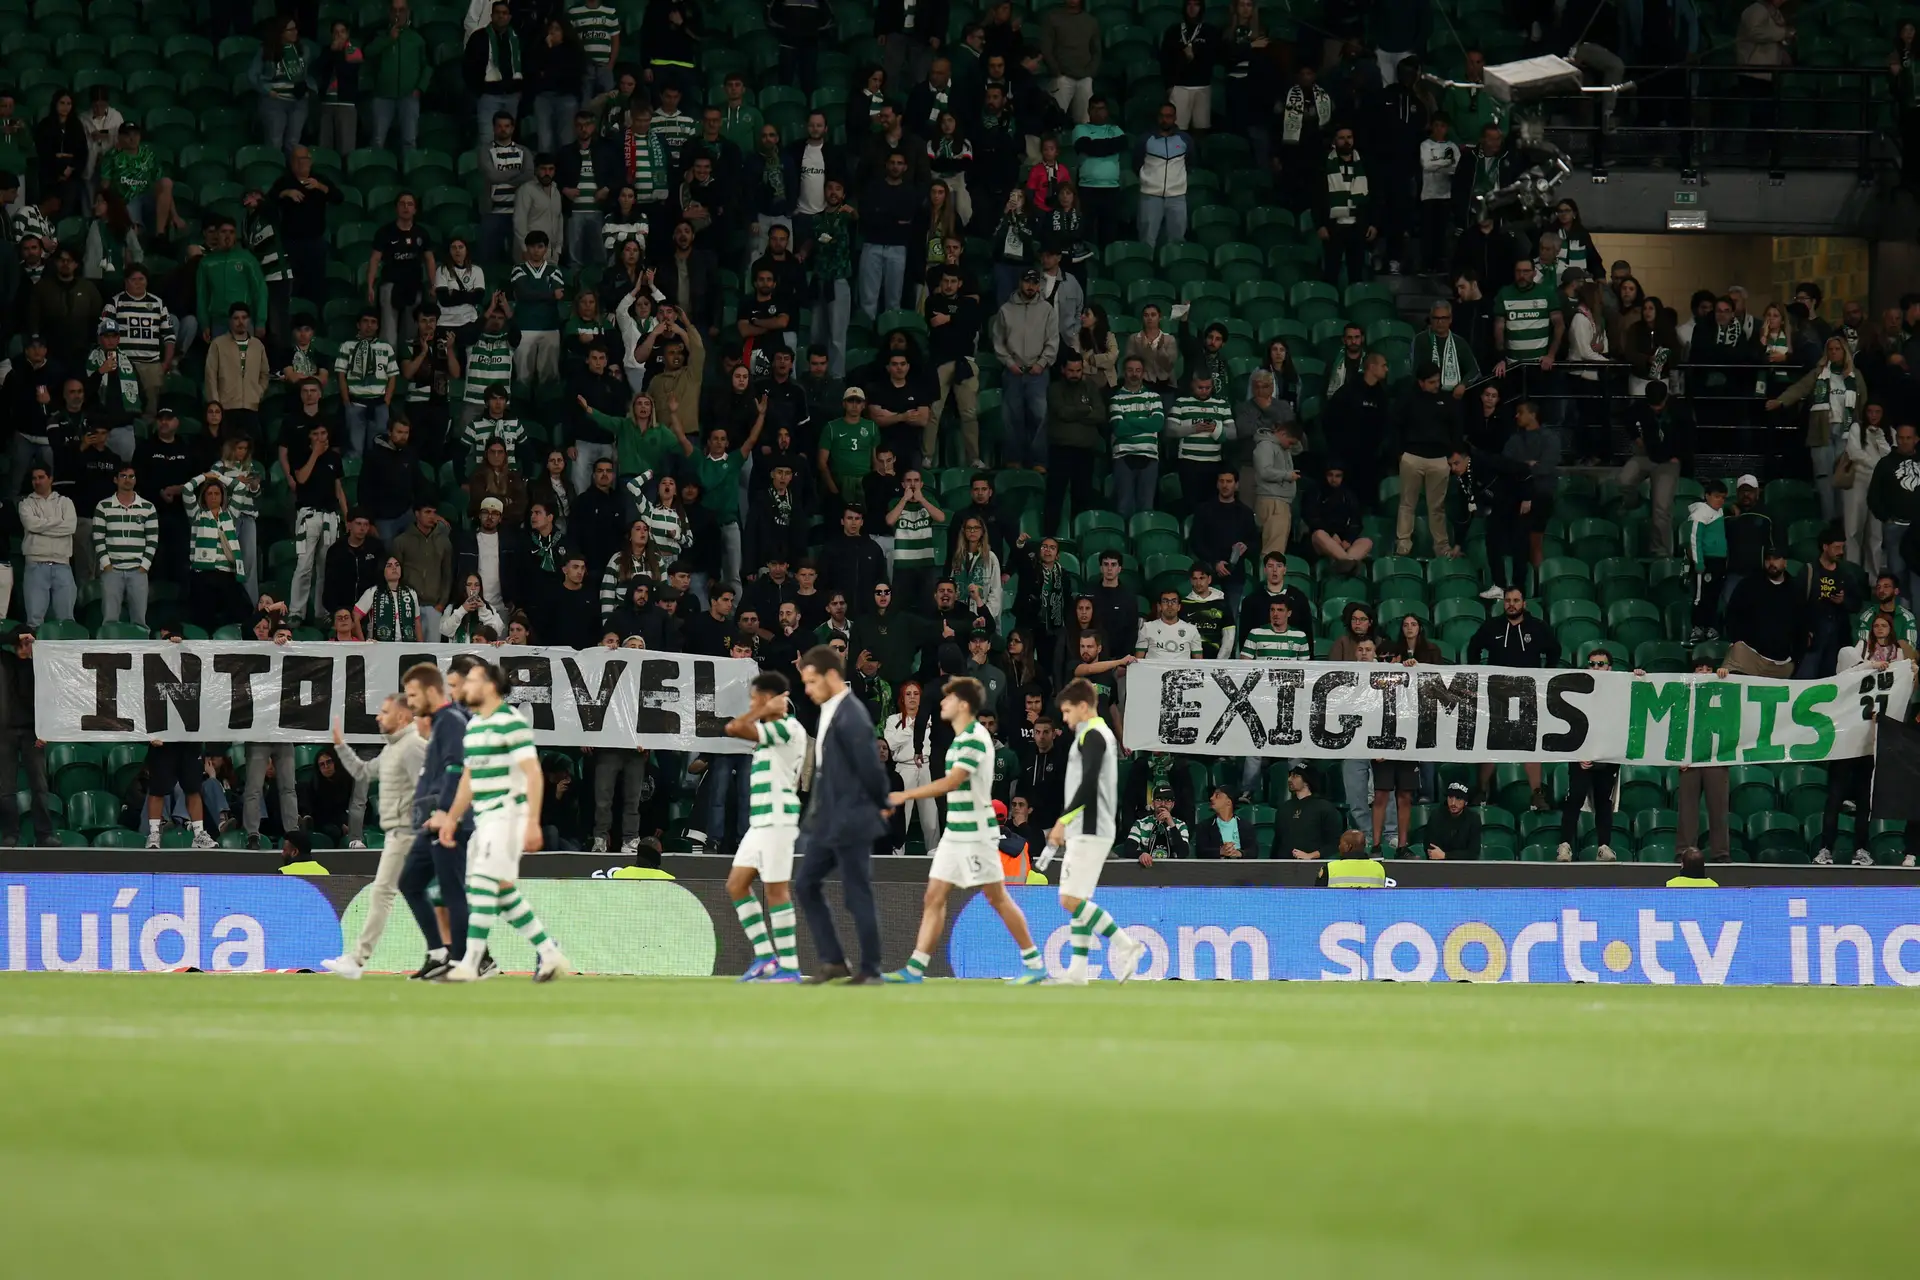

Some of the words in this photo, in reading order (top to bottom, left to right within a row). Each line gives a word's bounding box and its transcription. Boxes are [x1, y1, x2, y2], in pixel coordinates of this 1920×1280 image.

[851, 438, 858, 451] 3
[1156, 640, 1185, 653] NOS
[81, 651, 734, 738] INTOLAVEL
[1158, 667, 1595, 752] EXIGIMOS
[1626, 681, 1838, 762] MAIS
[8, 885, 265, 971] luída
